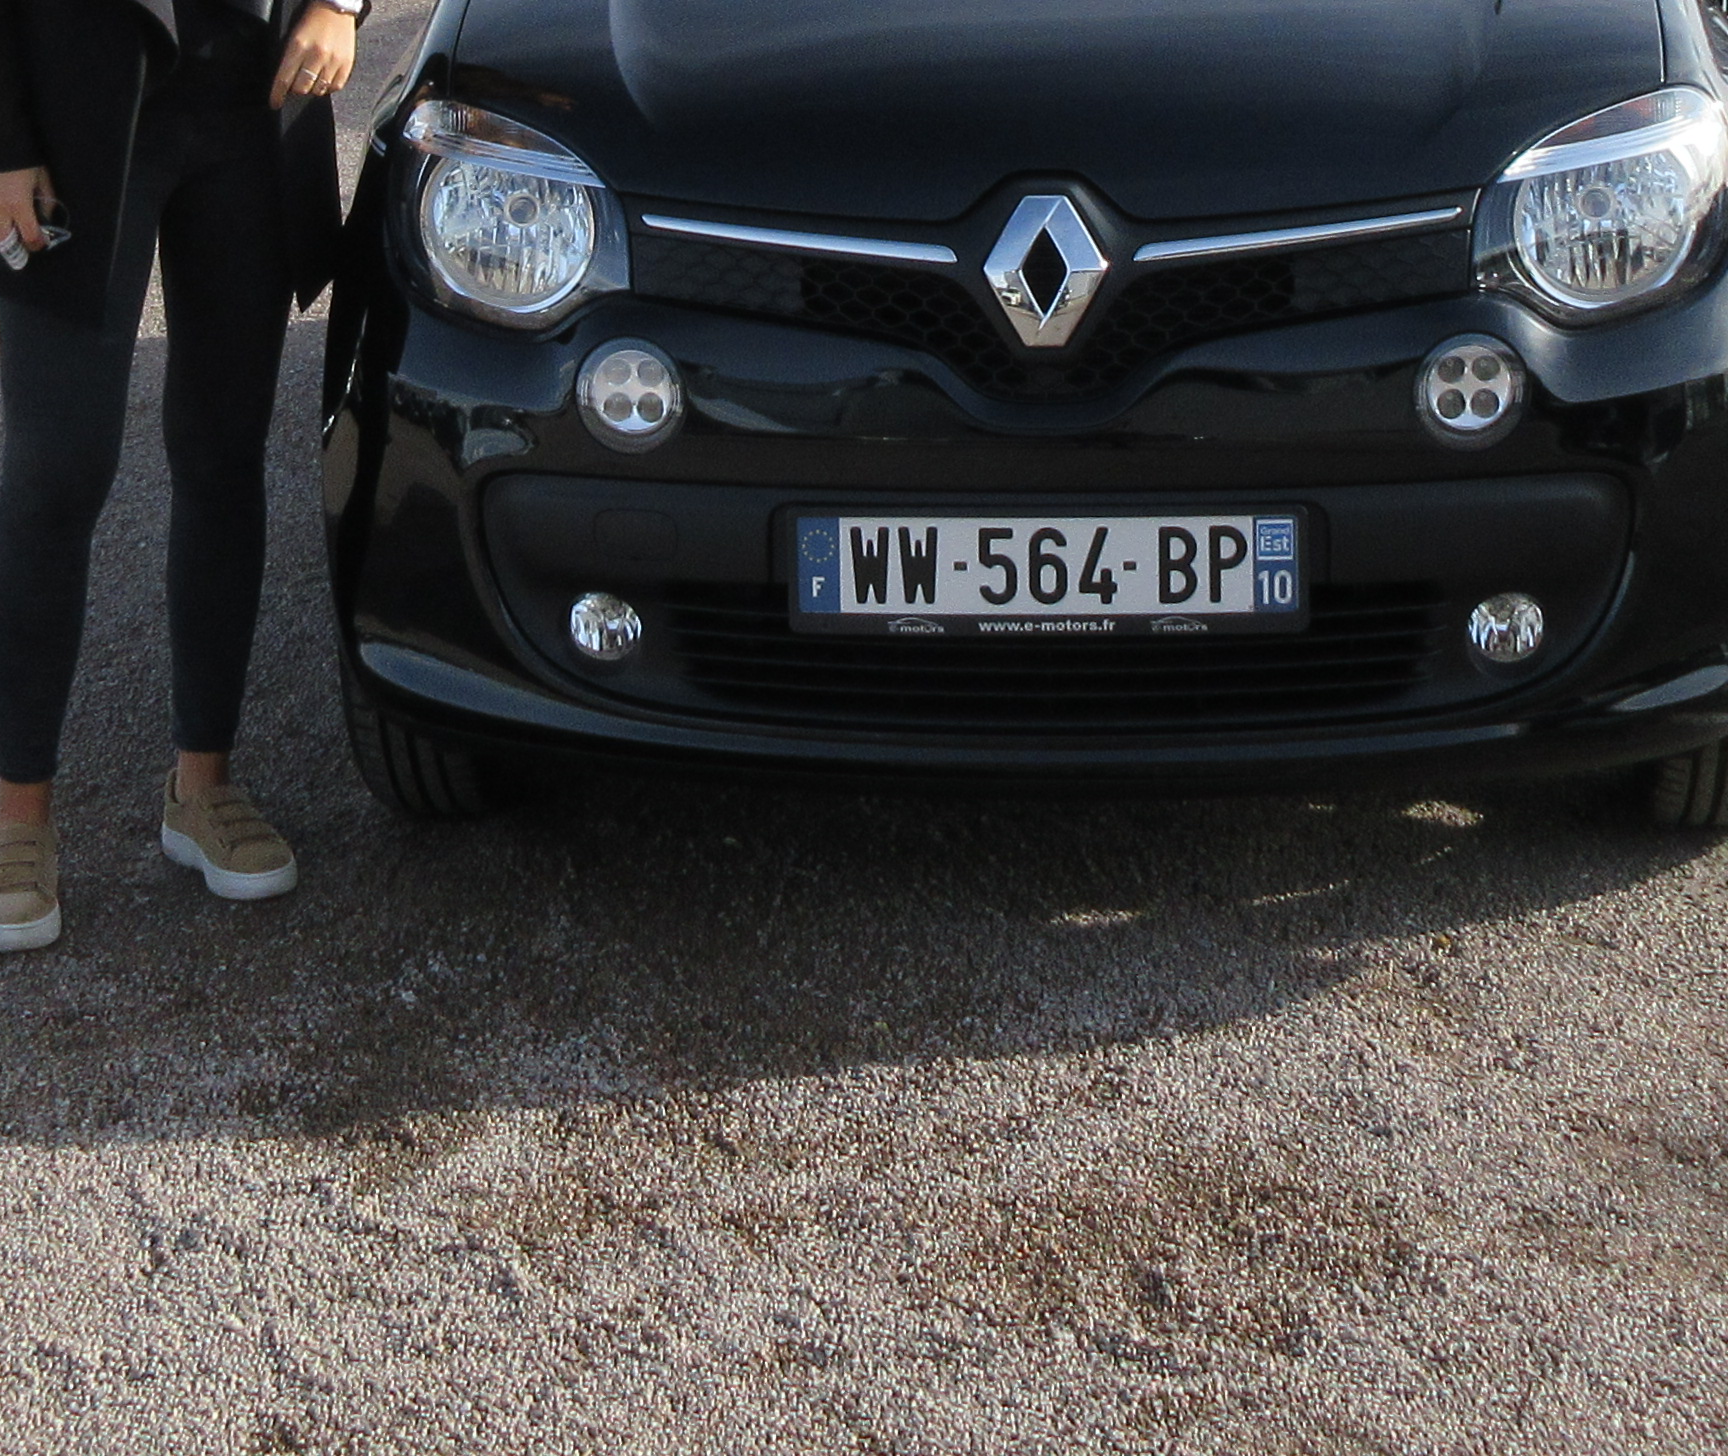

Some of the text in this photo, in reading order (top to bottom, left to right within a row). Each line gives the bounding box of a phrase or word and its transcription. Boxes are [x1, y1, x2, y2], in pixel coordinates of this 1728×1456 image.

[1260, 526, 1290, 535] Grand
[1260, 535, 1290, 552] Est
[849, 525, 1248, 605] WW-564-BP
[812, 576, 825, 598] F
[1258, 569, 1293, 605] 10
[978, 619, 1116, 633] www.e-motors.fr
